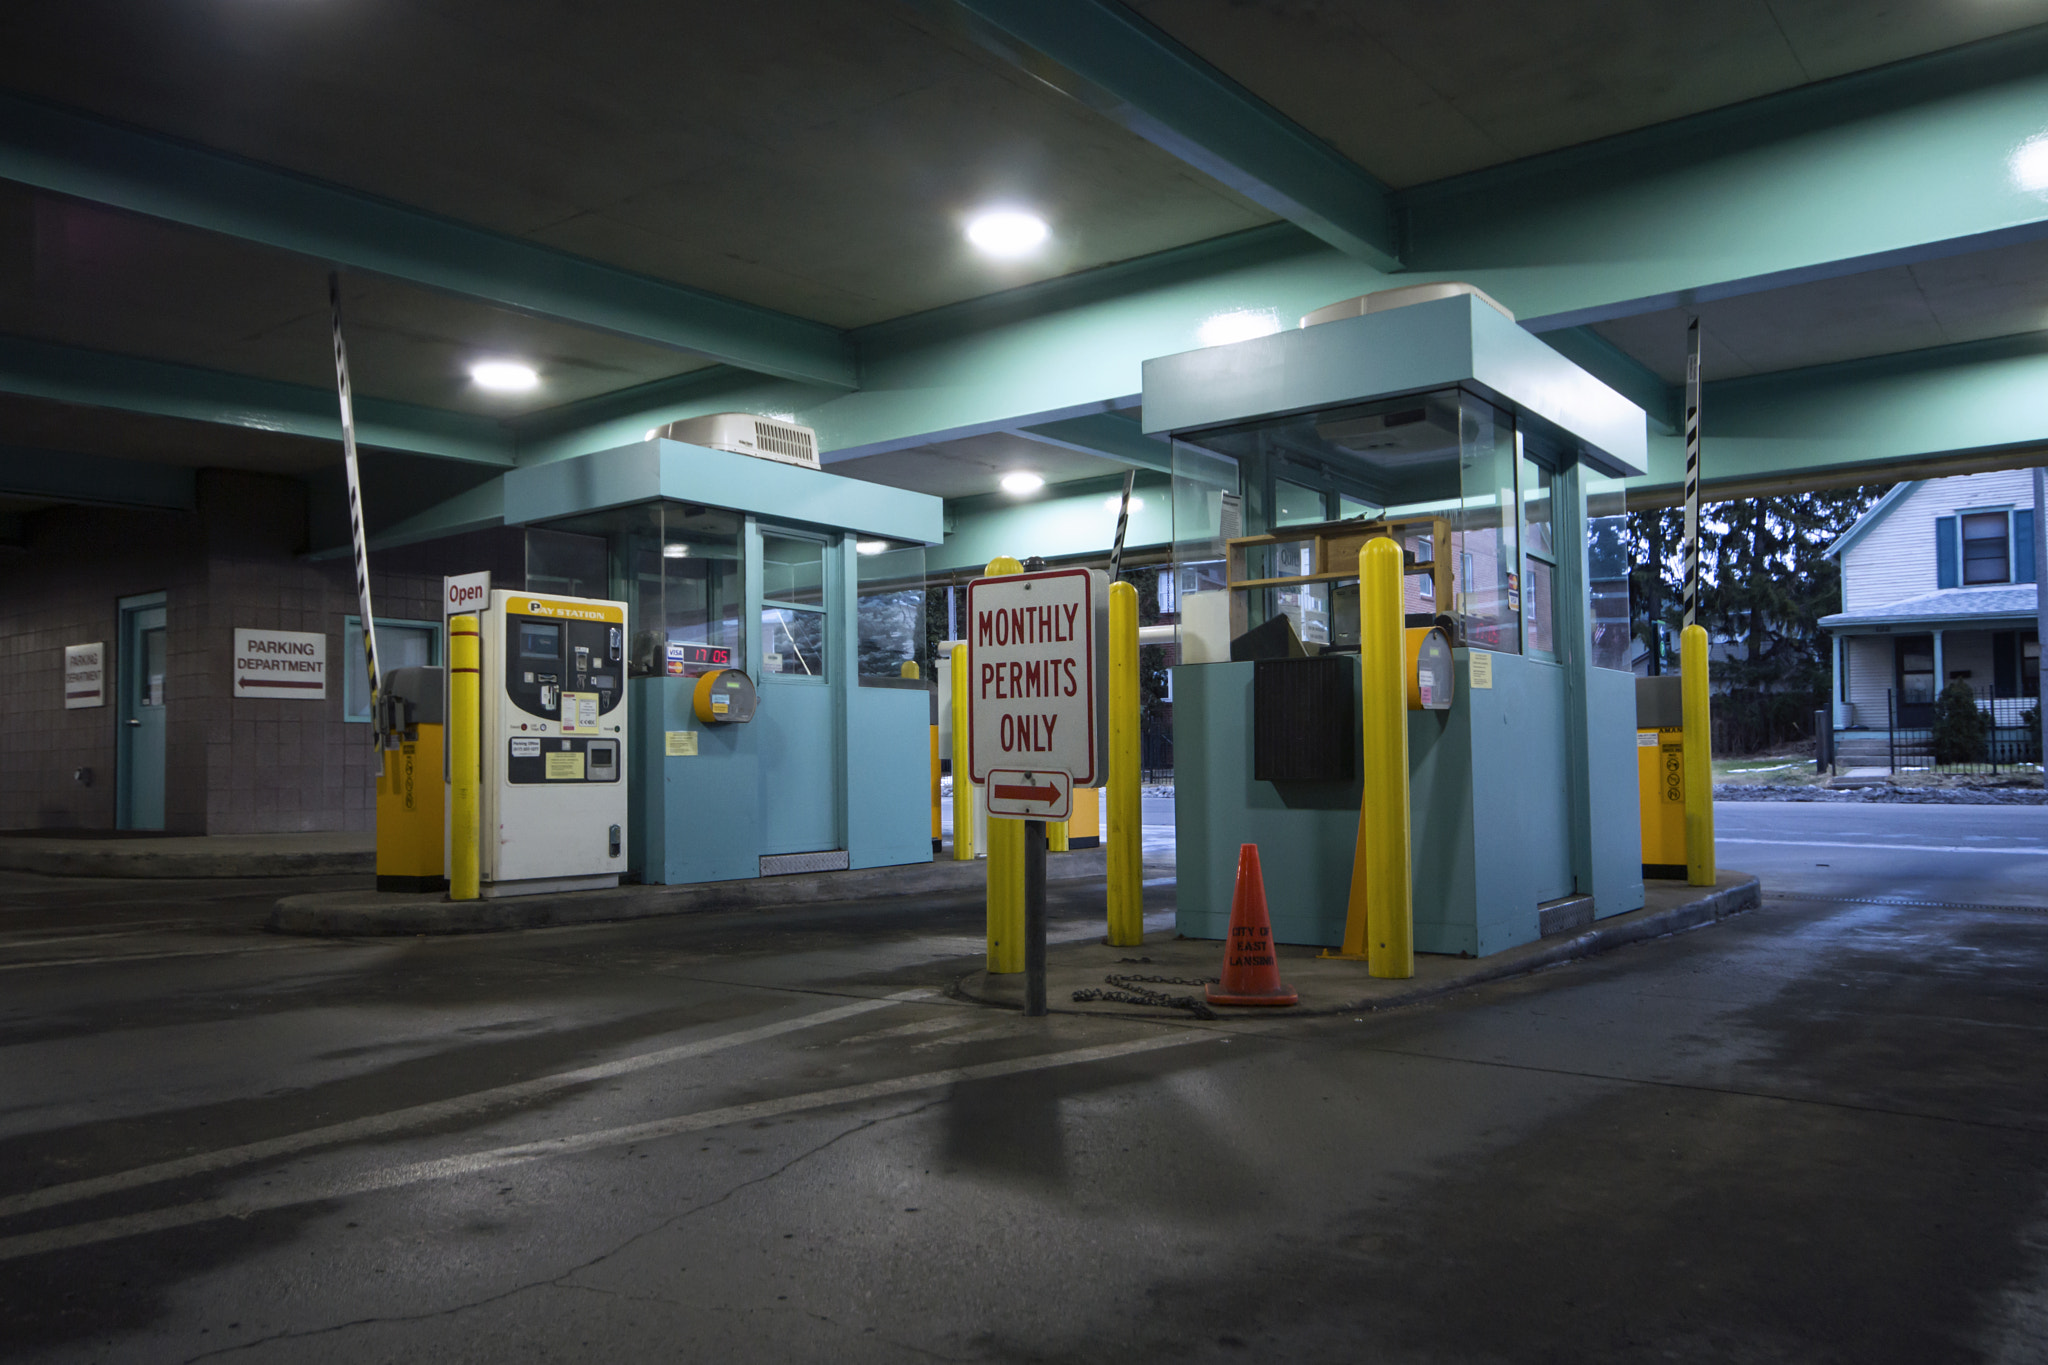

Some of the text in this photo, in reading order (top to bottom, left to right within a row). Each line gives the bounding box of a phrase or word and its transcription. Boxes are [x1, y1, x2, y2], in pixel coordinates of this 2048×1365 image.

[449, 584, 483, 606] Open
[530, 602, 605, 620] PAY STATION
[978, 602, 1079, 647] MONTHLY
[247, 640, 315, 656] PARKING
[237, 657, 323, 673] DEPARTMENT
[981, 657, 1078, 699] PERMITS
[1000, 713, 1058, 752] ONLY
[1232, 927, 1254, 936] CITY
[1237, 941, 1267, 952] EAST
[1230, 956, 1274, 966] LANSING
